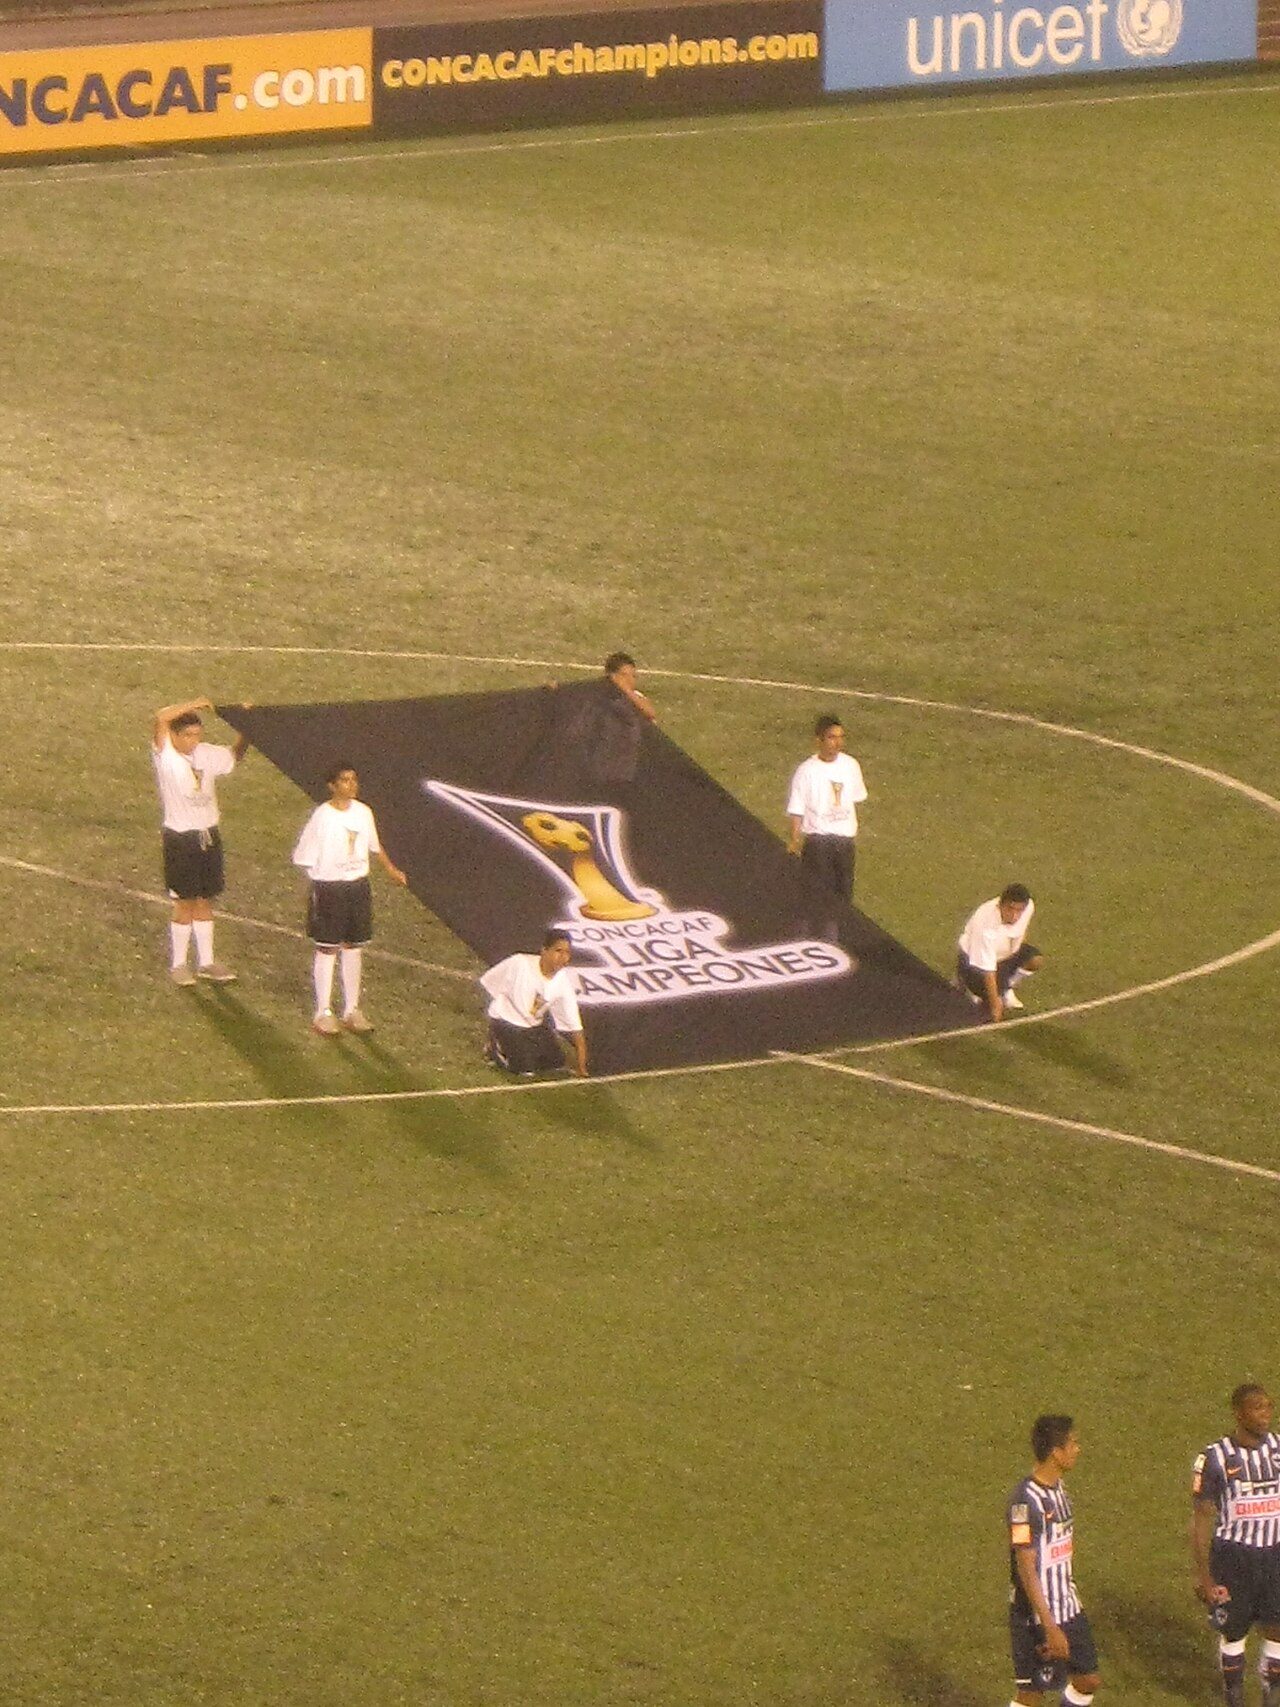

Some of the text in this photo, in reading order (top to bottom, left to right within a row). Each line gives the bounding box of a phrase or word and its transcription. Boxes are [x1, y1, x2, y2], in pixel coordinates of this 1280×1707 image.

[381, 32, 819, 88] CONCACAFchampions.com
[906, 0, 1109, 76] unicef
[568, 917, 714, 943] CONCACAF
[601, 937, 724, 968] LIGA
[575, 946, 839, 996] AMPEONES
